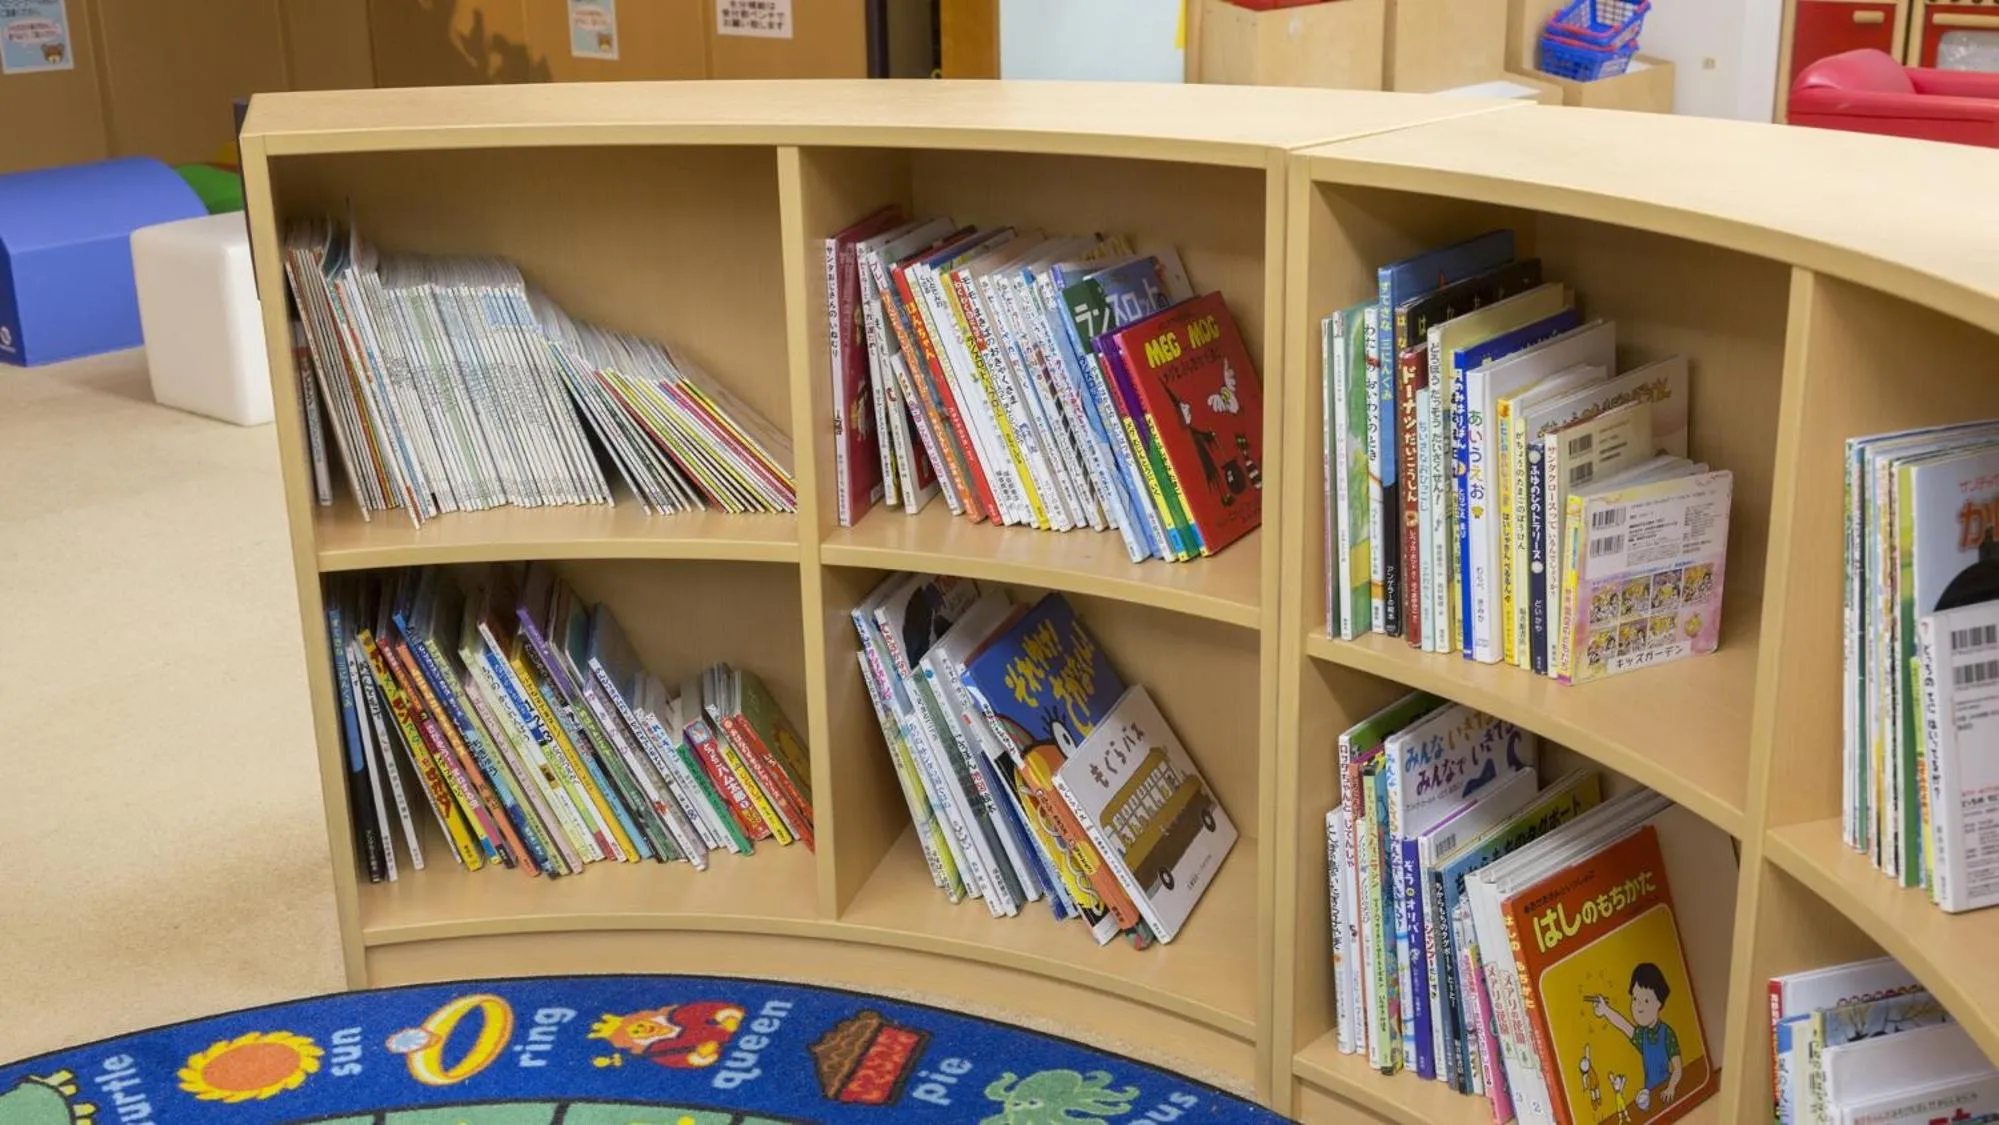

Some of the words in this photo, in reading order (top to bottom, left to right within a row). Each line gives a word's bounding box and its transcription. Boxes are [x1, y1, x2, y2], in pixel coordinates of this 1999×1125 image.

[1144, 331, 1182, 369] MEG
[1187, 314, 1220, 349] MOG
[1402, 366, 1418, 502] ドーナツだいこうしん
[1468, 410, 1485, 500] あいうえお
[1616, 646, 1684, 669] キッズガーデン
[1089, 722, 1146, 788] もぐらバス
[1405, 733, 1445, 773] みんな
[1533, 871, 1657, 953] はしのもちかた
[331, 1027, 363, 1077] sun
[514, 1007, 577, 1068] ring
[712, 1000, 793, 1089] queen
[94, 1054, 156, 1125] urtle
[912, 1057, 973, 1106] pie
